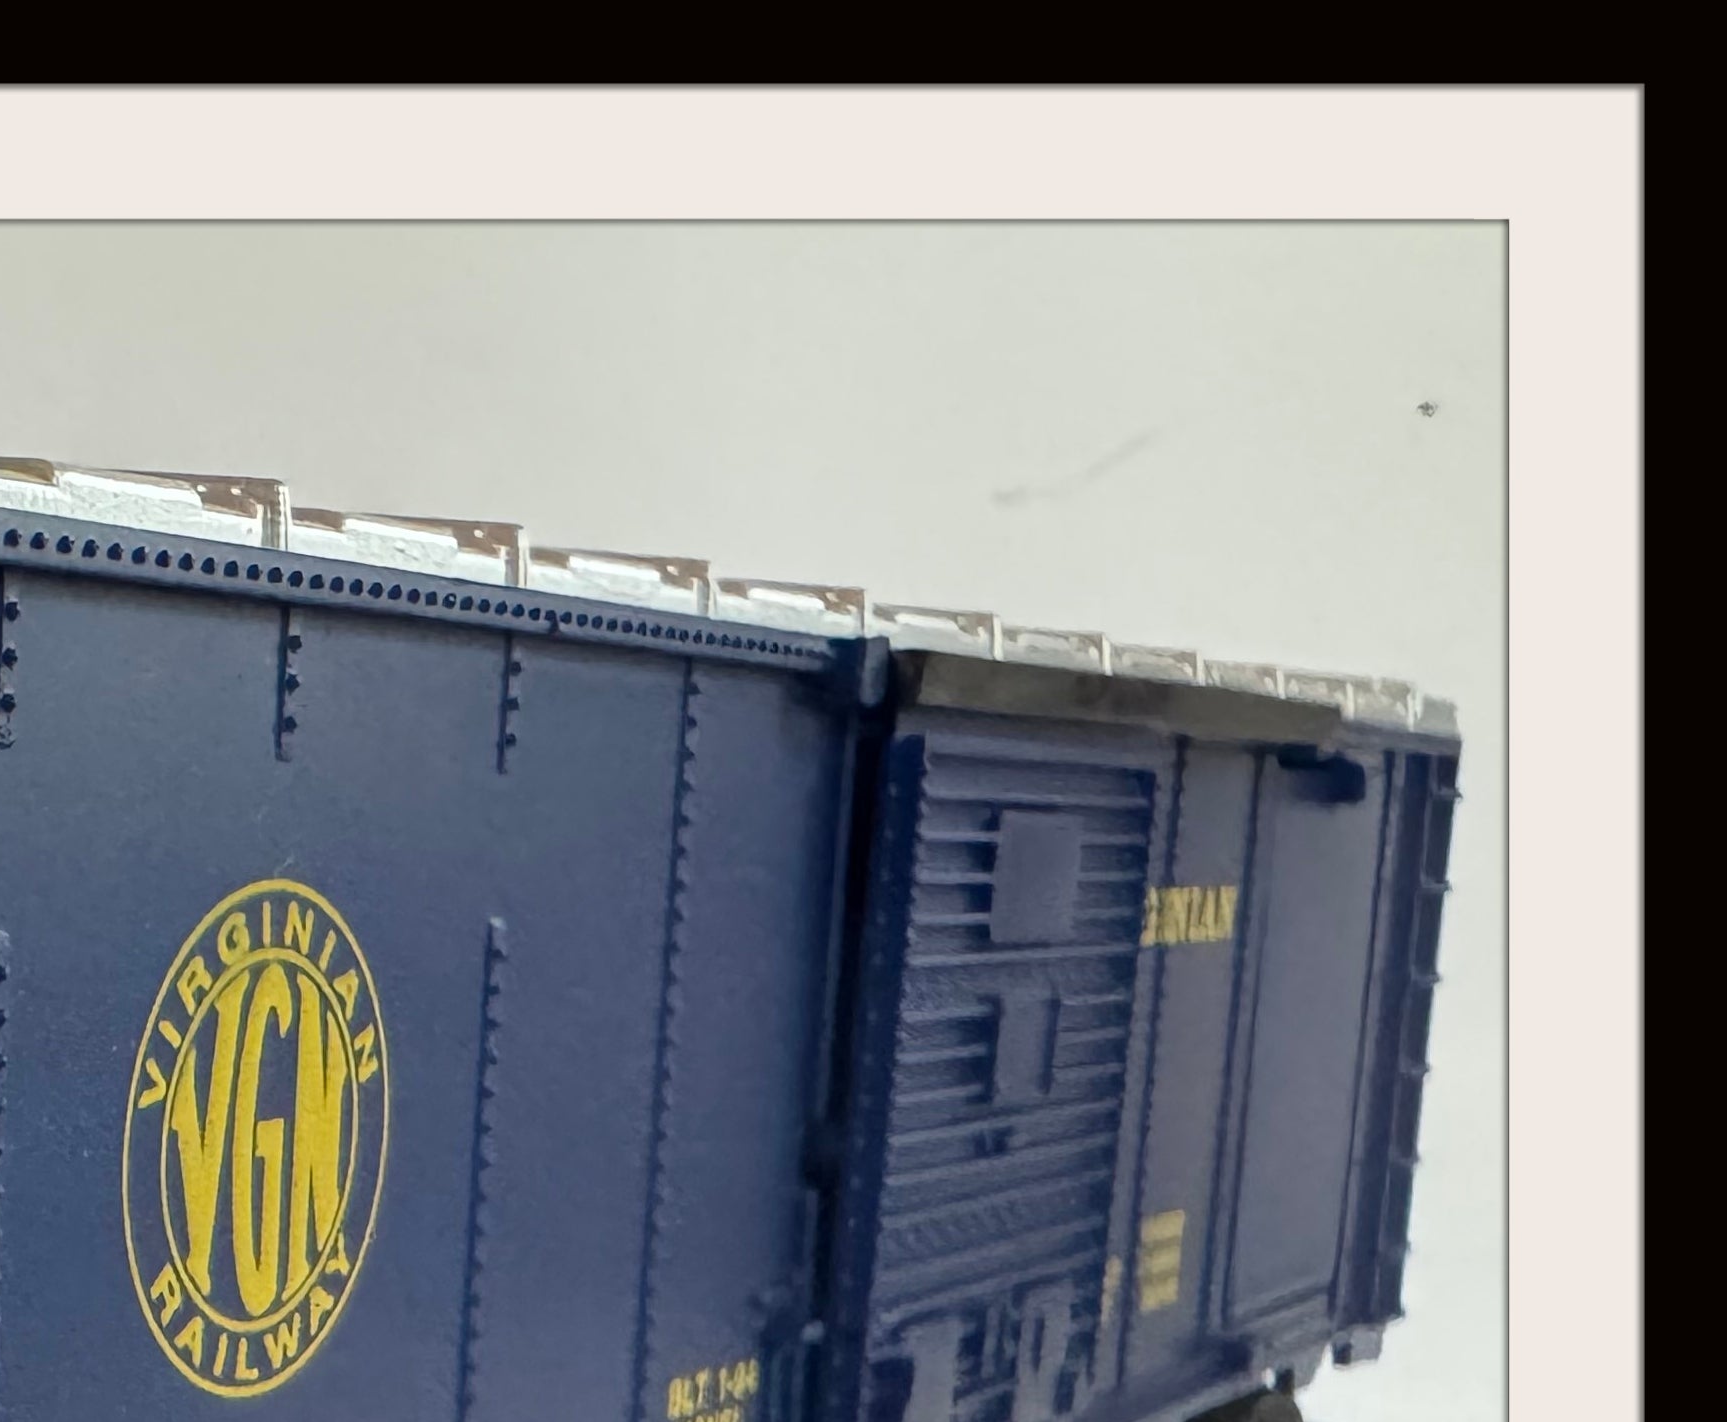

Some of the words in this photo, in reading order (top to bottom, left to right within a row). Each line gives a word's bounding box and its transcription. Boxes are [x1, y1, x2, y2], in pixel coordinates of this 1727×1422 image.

[138, 901, 378, 1109] VIRGINIAN
[170, 962, 348, 1318] VGN
[150, 1234, 350, 1381] RAILWAY
[667, 1367, 710, 1420] BLT
